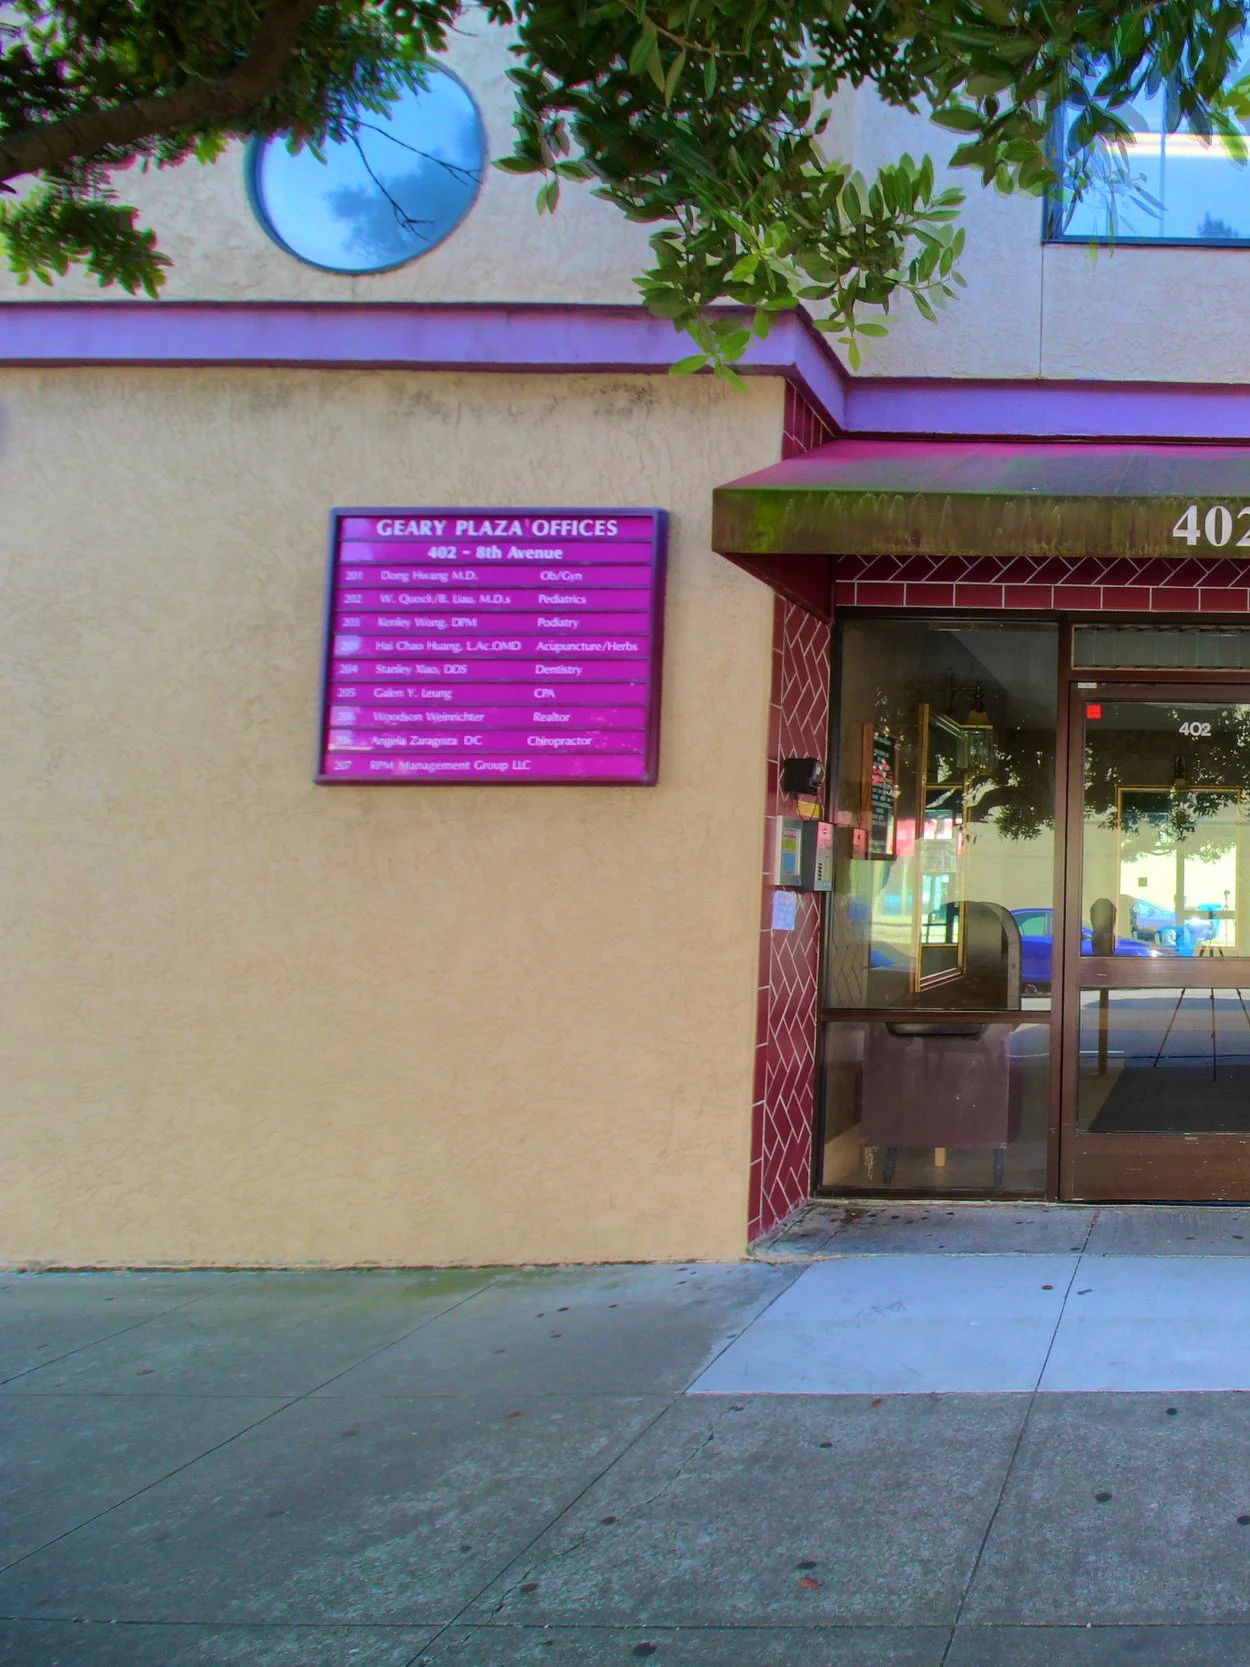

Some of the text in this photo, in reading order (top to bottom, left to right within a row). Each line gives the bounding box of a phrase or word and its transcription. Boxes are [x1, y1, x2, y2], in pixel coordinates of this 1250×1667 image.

[376, 519, 618, 536] GEARY PLAZA OFFICES
[427, 545, 457, 559] 402
[475, 545, 502, 559] 8th
[507, 545, 563, 559] Avenue
[539, 570, 583, 583] Ob/Gyn
[538, 593, 587, 604] Pediatrics
[451, 617, 478, 628] DPM
[537, 616, 580, 630] Podiatry
[375, 641, 394, 651] Hai
[395, 641, 424, 651] Chao
[536, 640, 639, 654] Acupuncture/Herbs
[375, 664, 412, 676] Stanley
[443, 664, 468, 674] DDS
[535, 664, 584, 677] Dentistry
[373, 687, 404, 698] Galen
[421, 687, 453, 701] Leung
[533, 688, 556, 698] CPA
[373, 711, 423, 722] Woodson
[532, 711, 572, 722] Realtor
[1179, 721, 1212, 737] 402
[371, 735, 408, 748] Angela
[409, 735, 459, 748] Zaragoza
[463, 735, 484, 745] DC
[527, 735, 593, 748] Chiropractor
[398, 760, 471, 773] Management
[473, 760, 509, 772] Group
